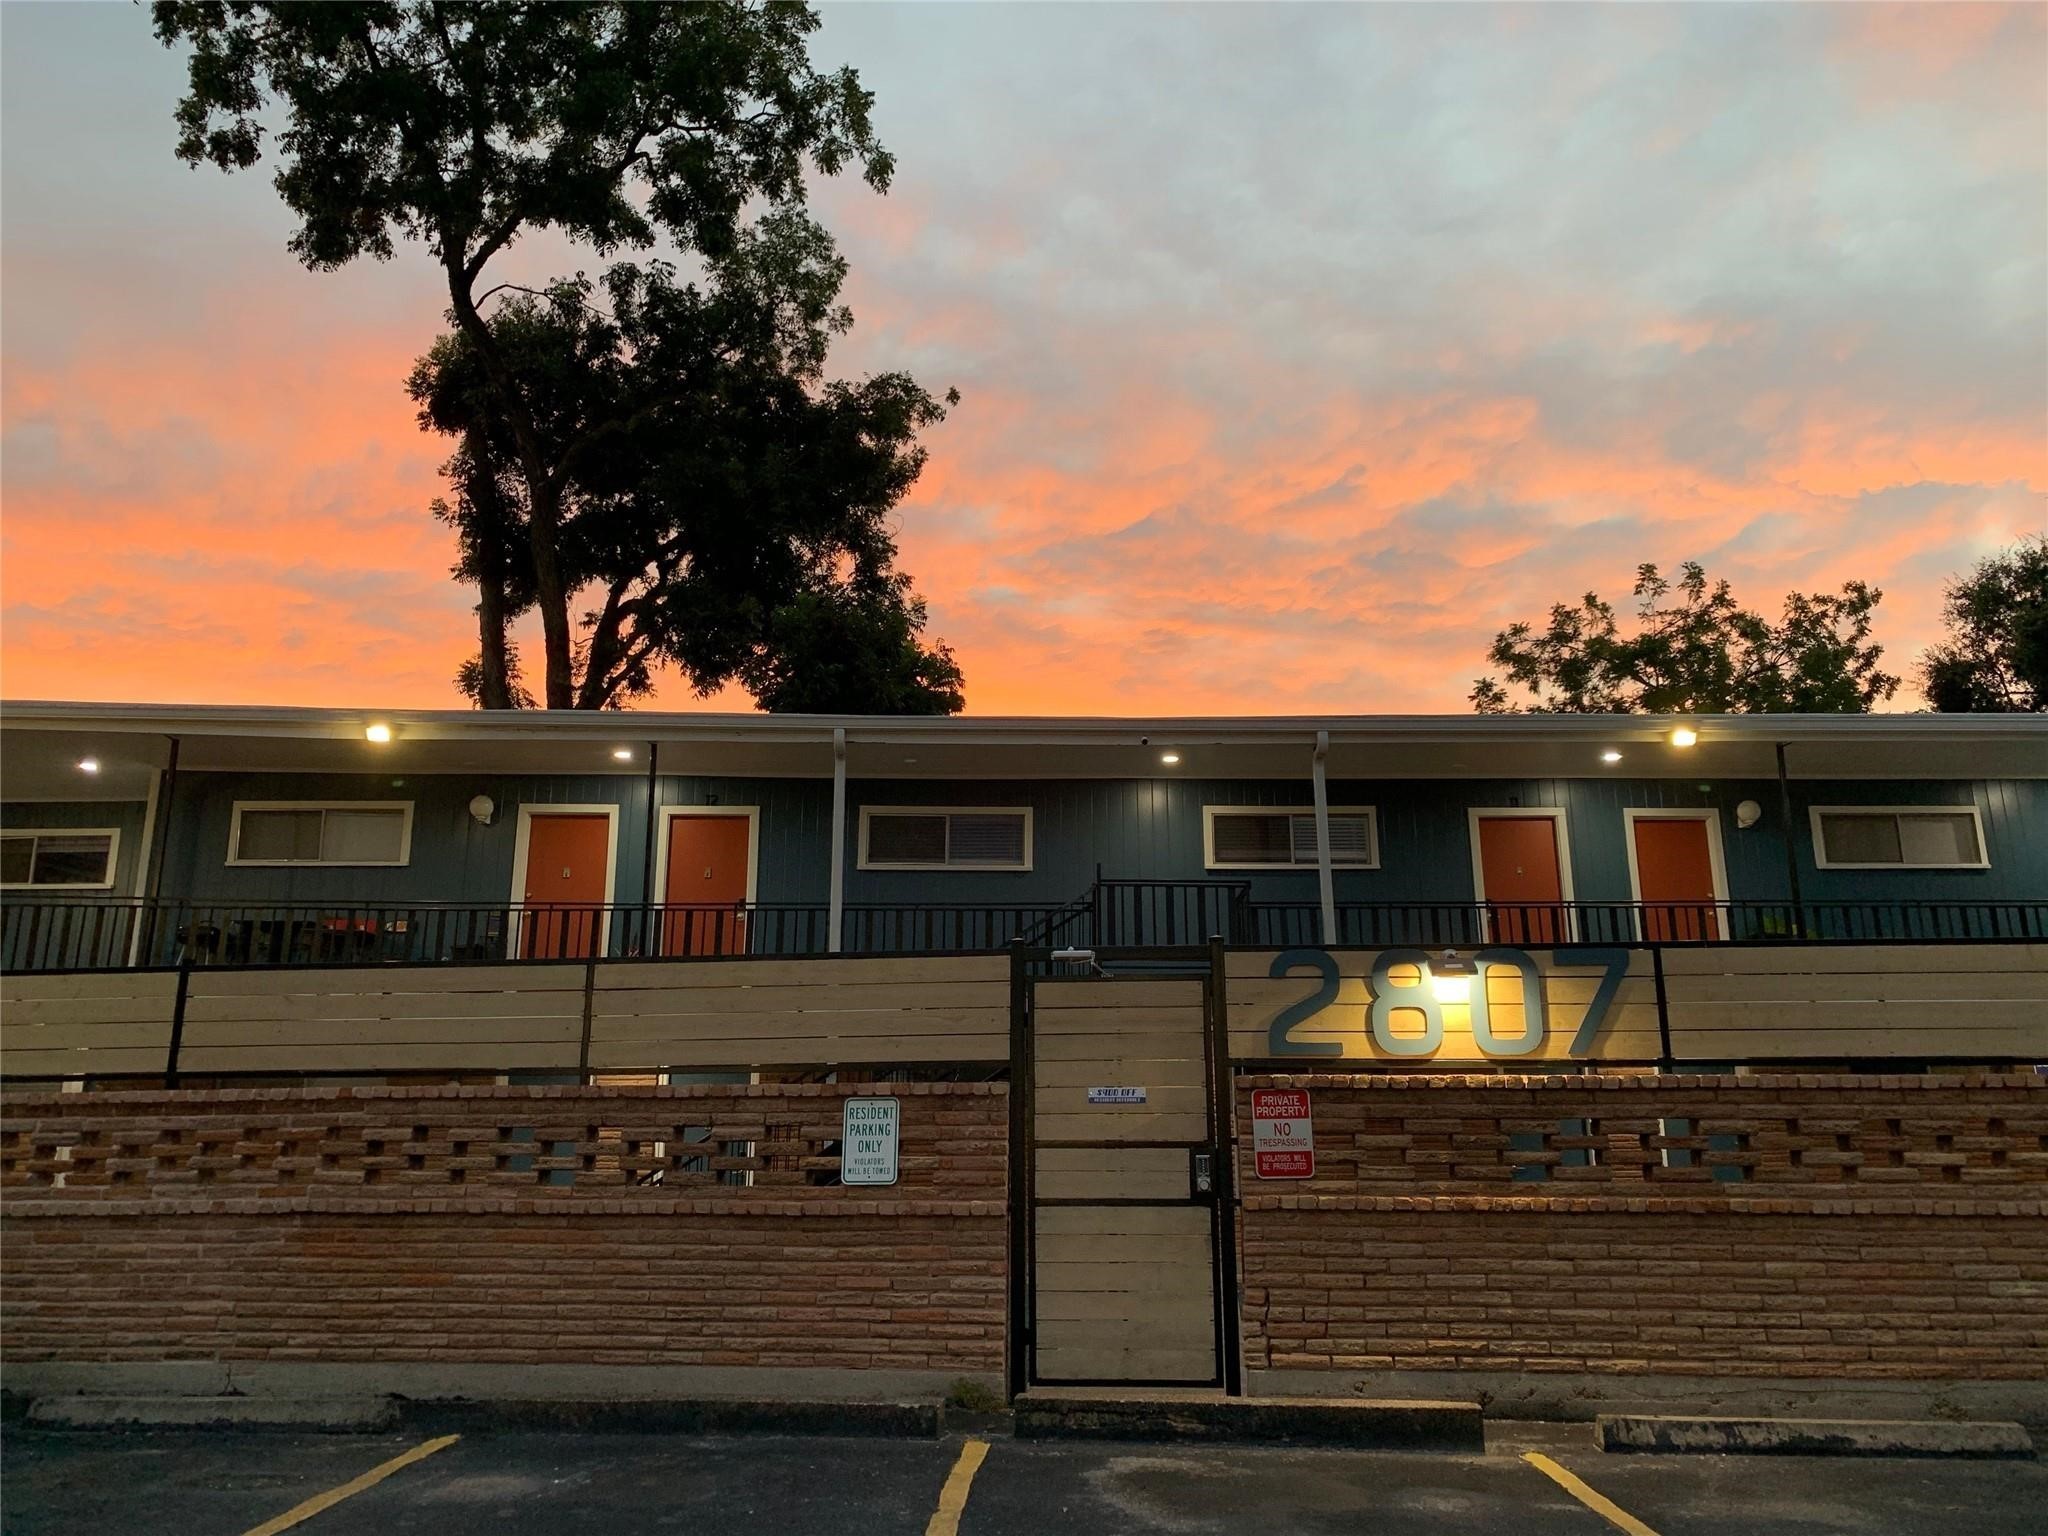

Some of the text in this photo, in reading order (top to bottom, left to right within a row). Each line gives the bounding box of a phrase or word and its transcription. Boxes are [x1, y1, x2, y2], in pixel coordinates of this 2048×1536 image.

[1268, 948, 1631, 1058] 2807
[1261, 1095, 1300, 1106] PRIVATE
[849, 1107, 894, 1120] RESIDENT
[1256, 1106, 1306, 1117] PROPERTY
[849, 1123, 891, 1136] PARKING
[1273, 1122, 1292, 1137] NO
[858, 1140, 883, 1153] ONLY
[1259, 1138, 1308, 1147] TRESPASSING
[854, 1157, 885, 1166] VIOLATORS
[1262, 1154, 1307, 1162] VIOLATORS WILL
[847, 1167, 891, 1175] WILL BE TOWED
[1262, 1162, 1308, 1170] BE PROSECUTED
